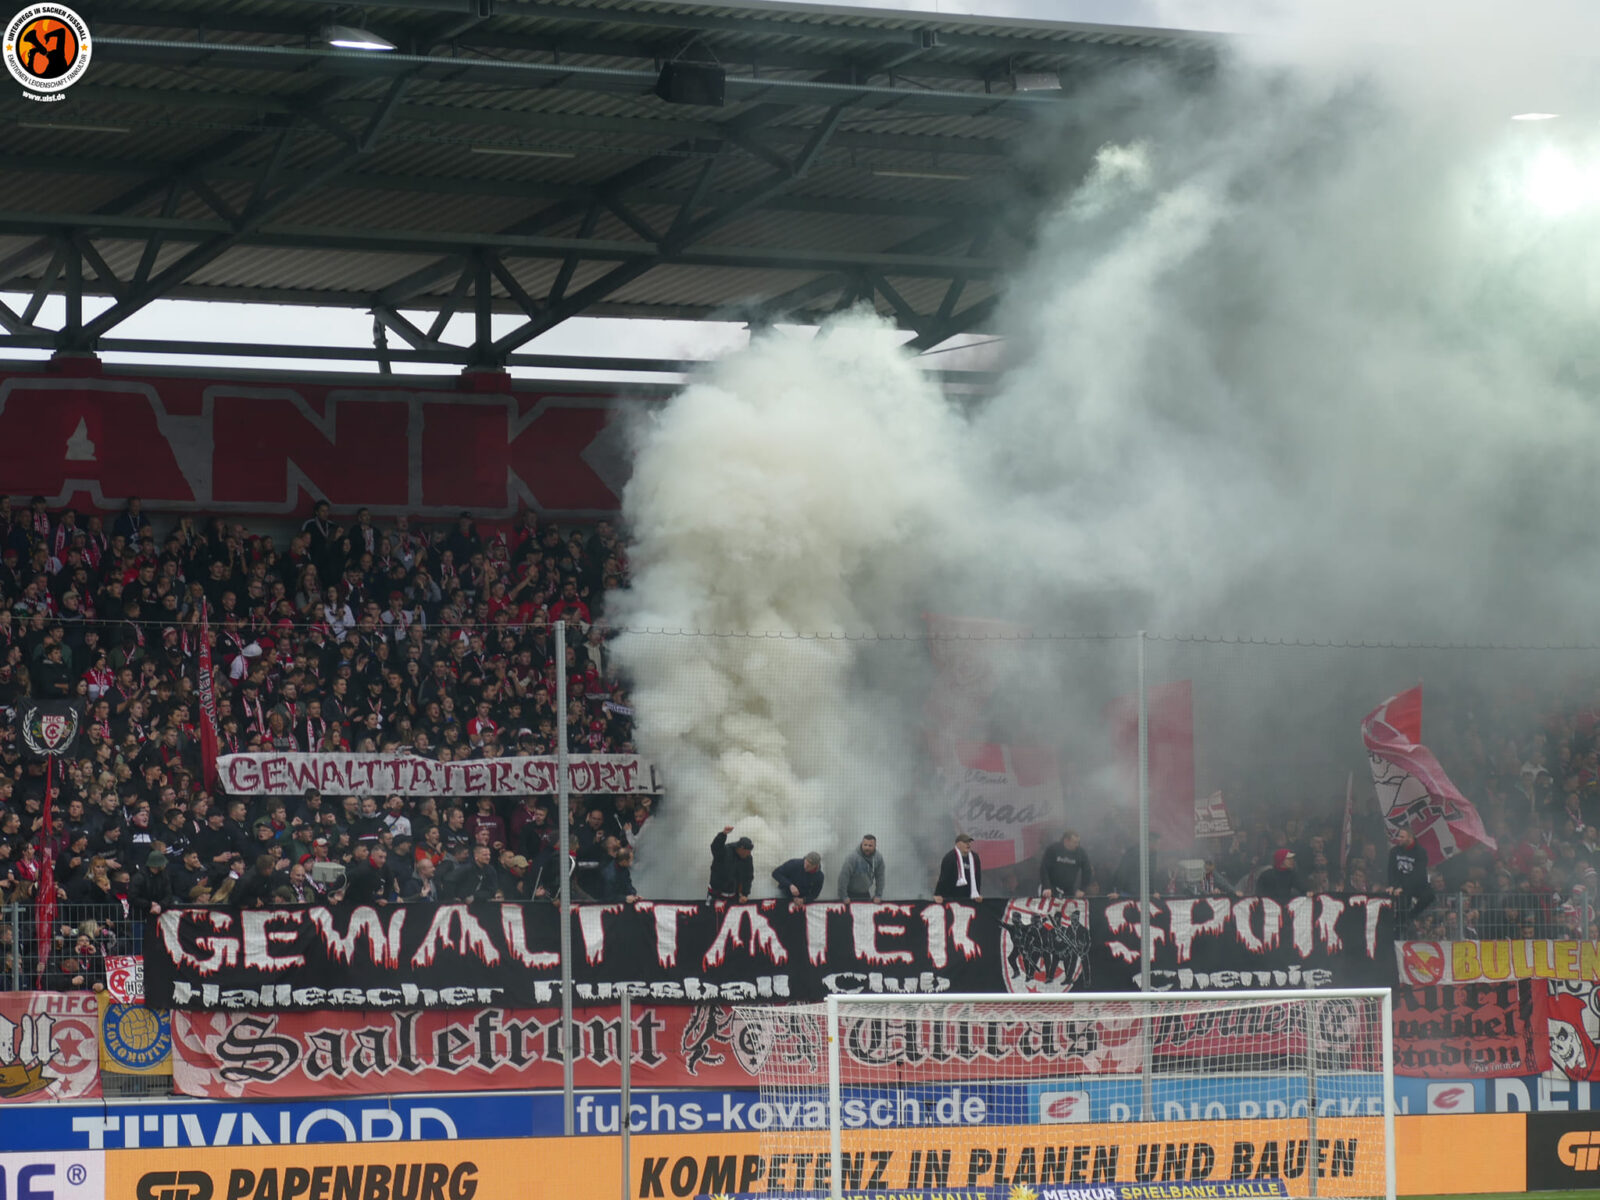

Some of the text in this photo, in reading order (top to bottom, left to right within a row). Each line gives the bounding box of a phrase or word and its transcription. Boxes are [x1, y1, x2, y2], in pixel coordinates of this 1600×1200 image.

[1103, 895, 1391, 960] SPORT
[1451, 939, 1600, 982] BULLEN
[46, 995, 99, 1014] HFC
[173, 980, 504, 1008] Hallescher
[216, 1008, 663, 1082] Saalefront
[226, 1161, 479, 1200] PAPENBURG
[638, 1138, 1358, 1198] KOMPETENZ IN PLANEN UND BAUEN
[1043, 1183, 1281, 1200] MERKUR SPIELBANK HALLE
